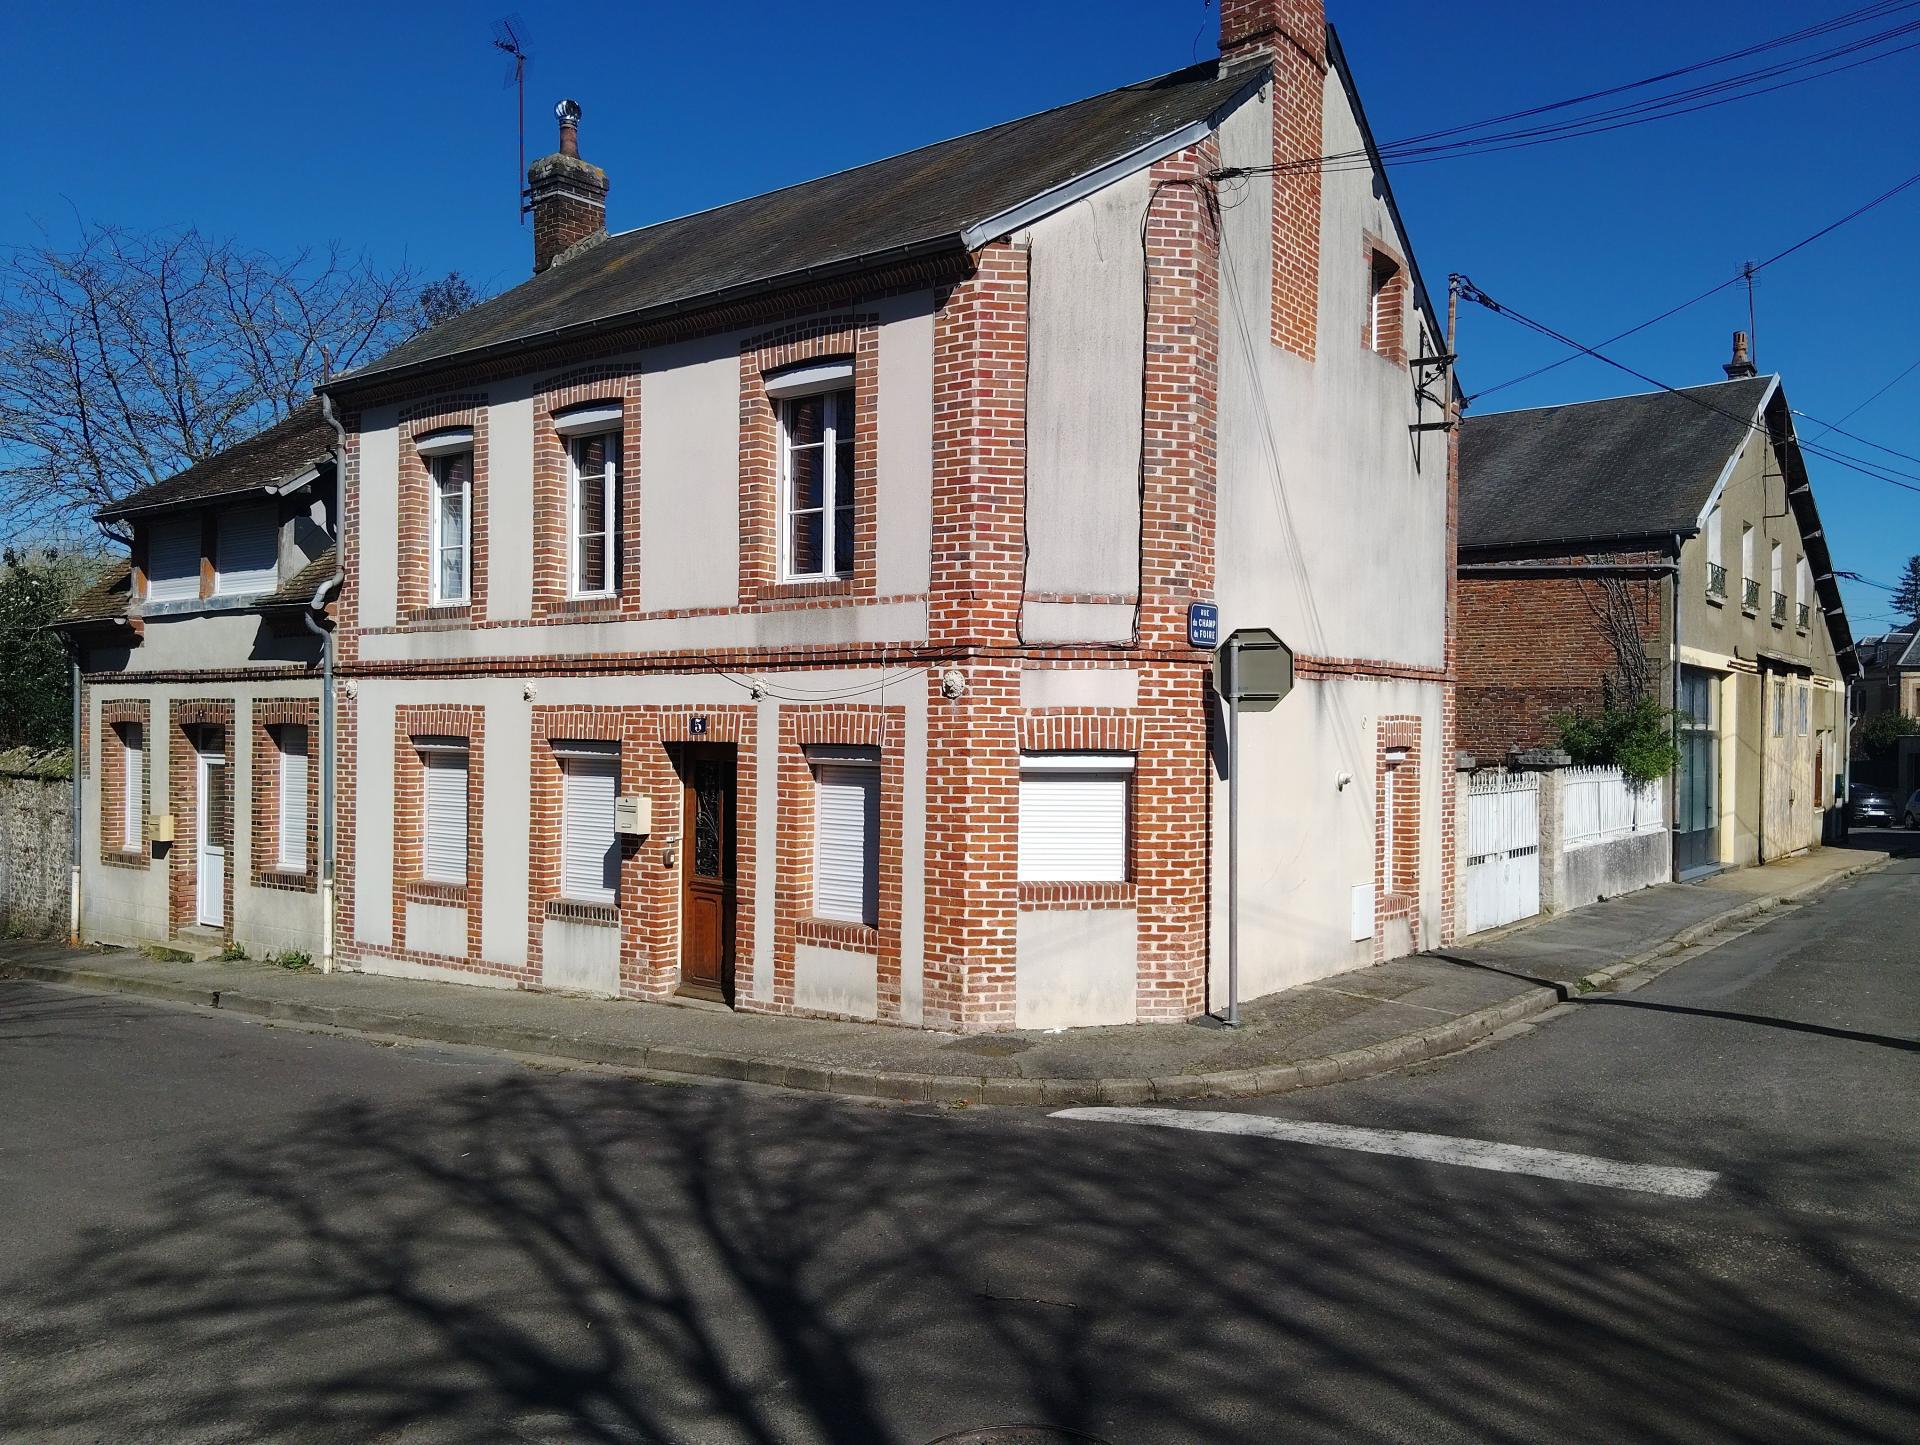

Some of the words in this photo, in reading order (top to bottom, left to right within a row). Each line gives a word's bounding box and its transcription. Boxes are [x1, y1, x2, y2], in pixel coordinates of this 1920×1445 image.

[1199, 618, 1216, 629] CHAMP
[1200, 629, 1215, 640] FOIRE
[695, 718, 702, 732] 5
